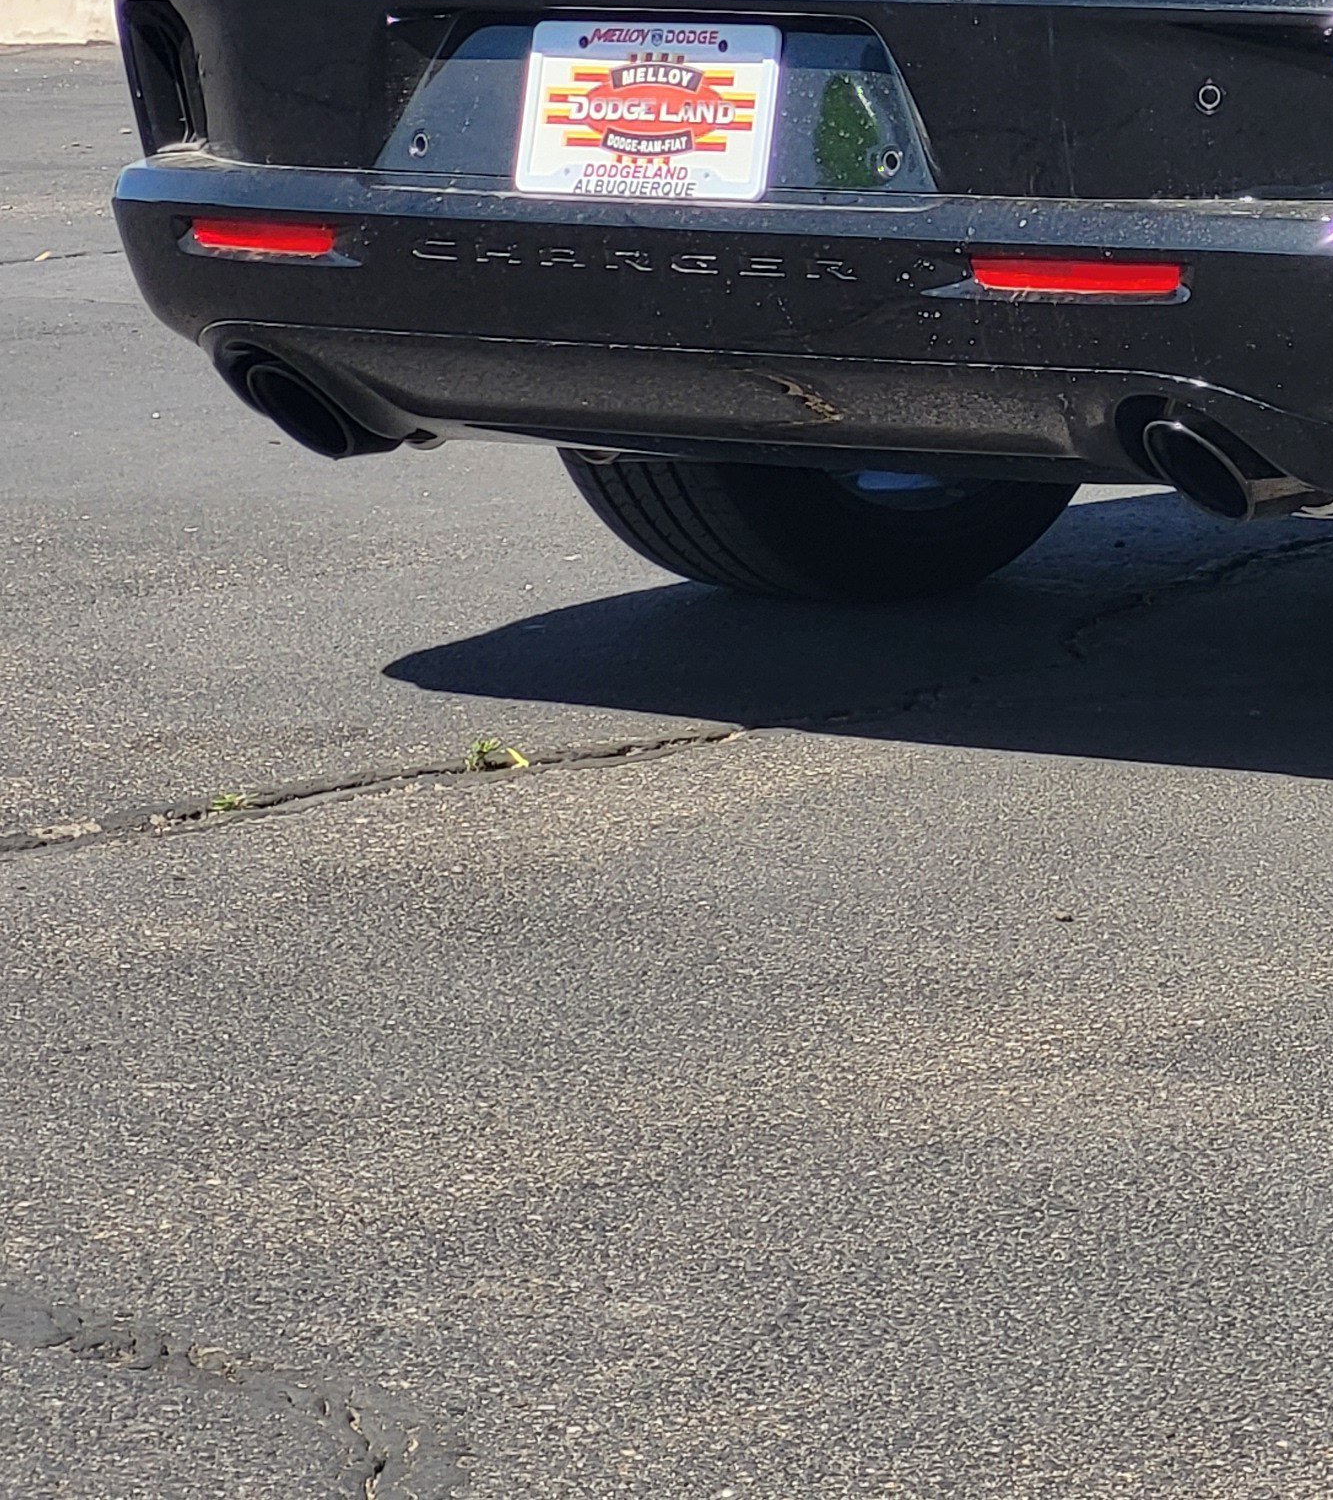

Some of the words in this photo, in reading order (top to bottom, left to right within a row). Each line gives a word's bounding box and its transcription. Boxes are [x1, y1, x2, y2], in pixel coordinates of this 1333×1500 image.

[589, 28, 650, 46] MELLOY
[664, 29, 719, 45] DODGE
[622, 68, 693, 88] MELLOY
[606, 133, 688, 154] DODGE-RAM-FIAT
[583, 163, 688, 181] DODGELAND
[573, 179, 697, 197] ALBUQUERQUE
[412, 241, 858, 281] CHARGER
